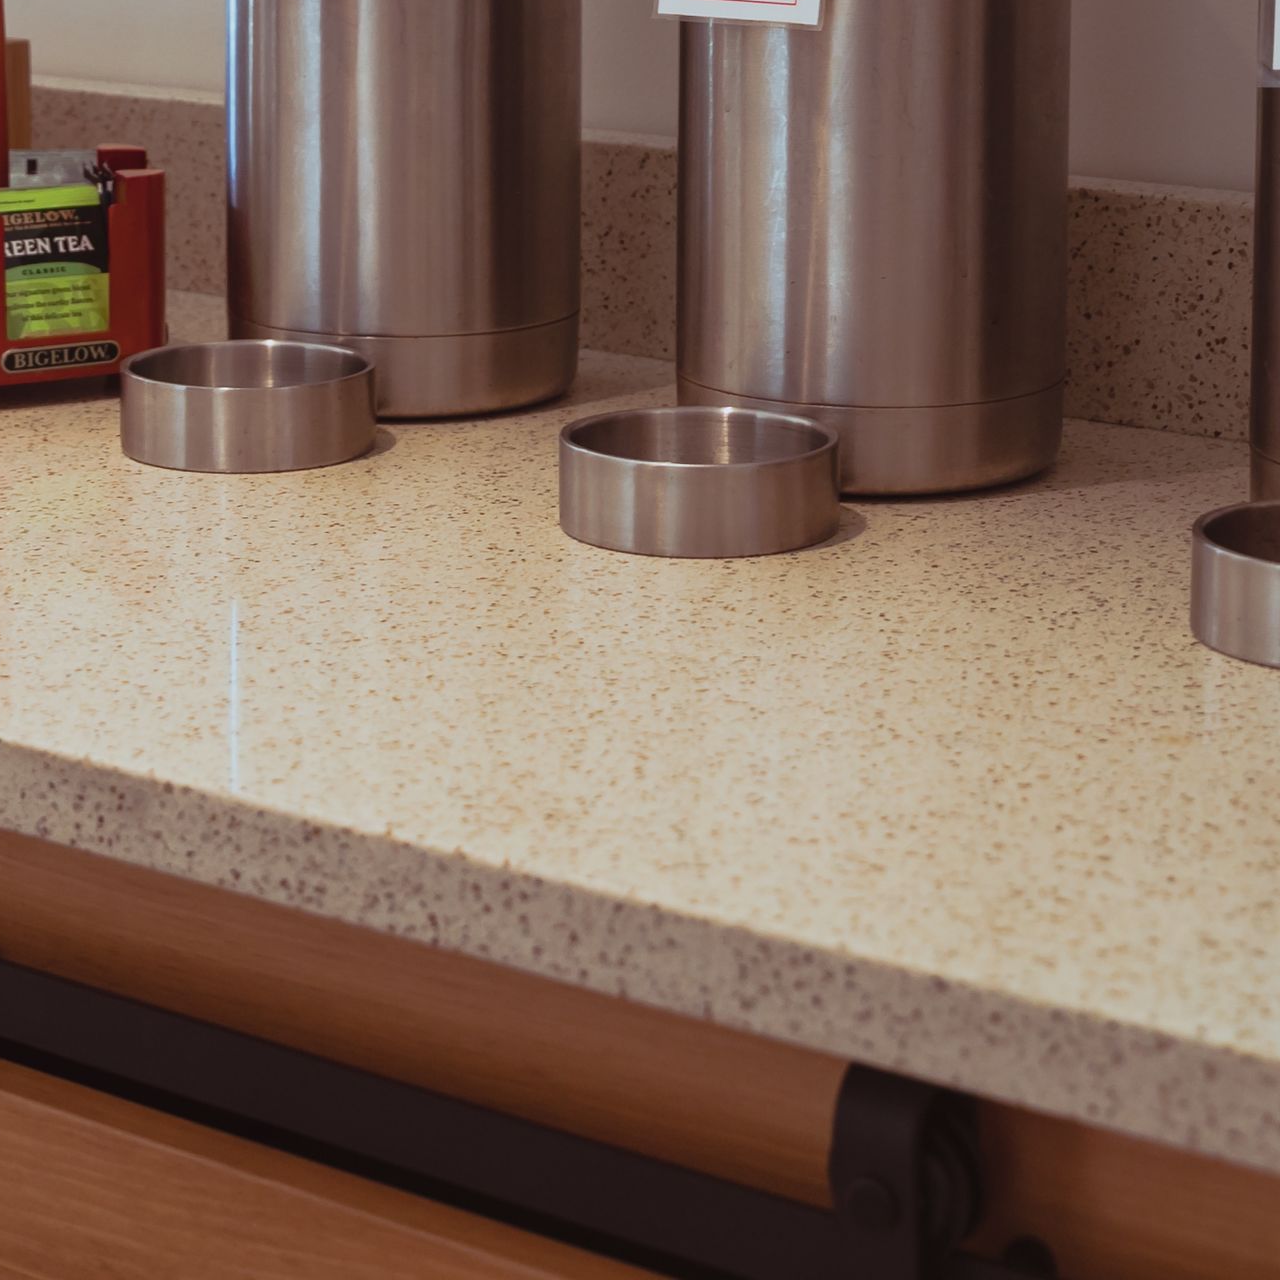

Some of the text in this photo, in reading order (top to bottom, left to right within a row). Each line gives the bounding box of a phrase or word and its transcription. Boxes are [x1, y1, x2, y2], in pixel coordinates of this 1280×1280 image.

[2, 209, 78, 226] IGELOW
[4, 234, 95, 257] REEN TEA
[13, 343, 109, 370] BIGELOW
